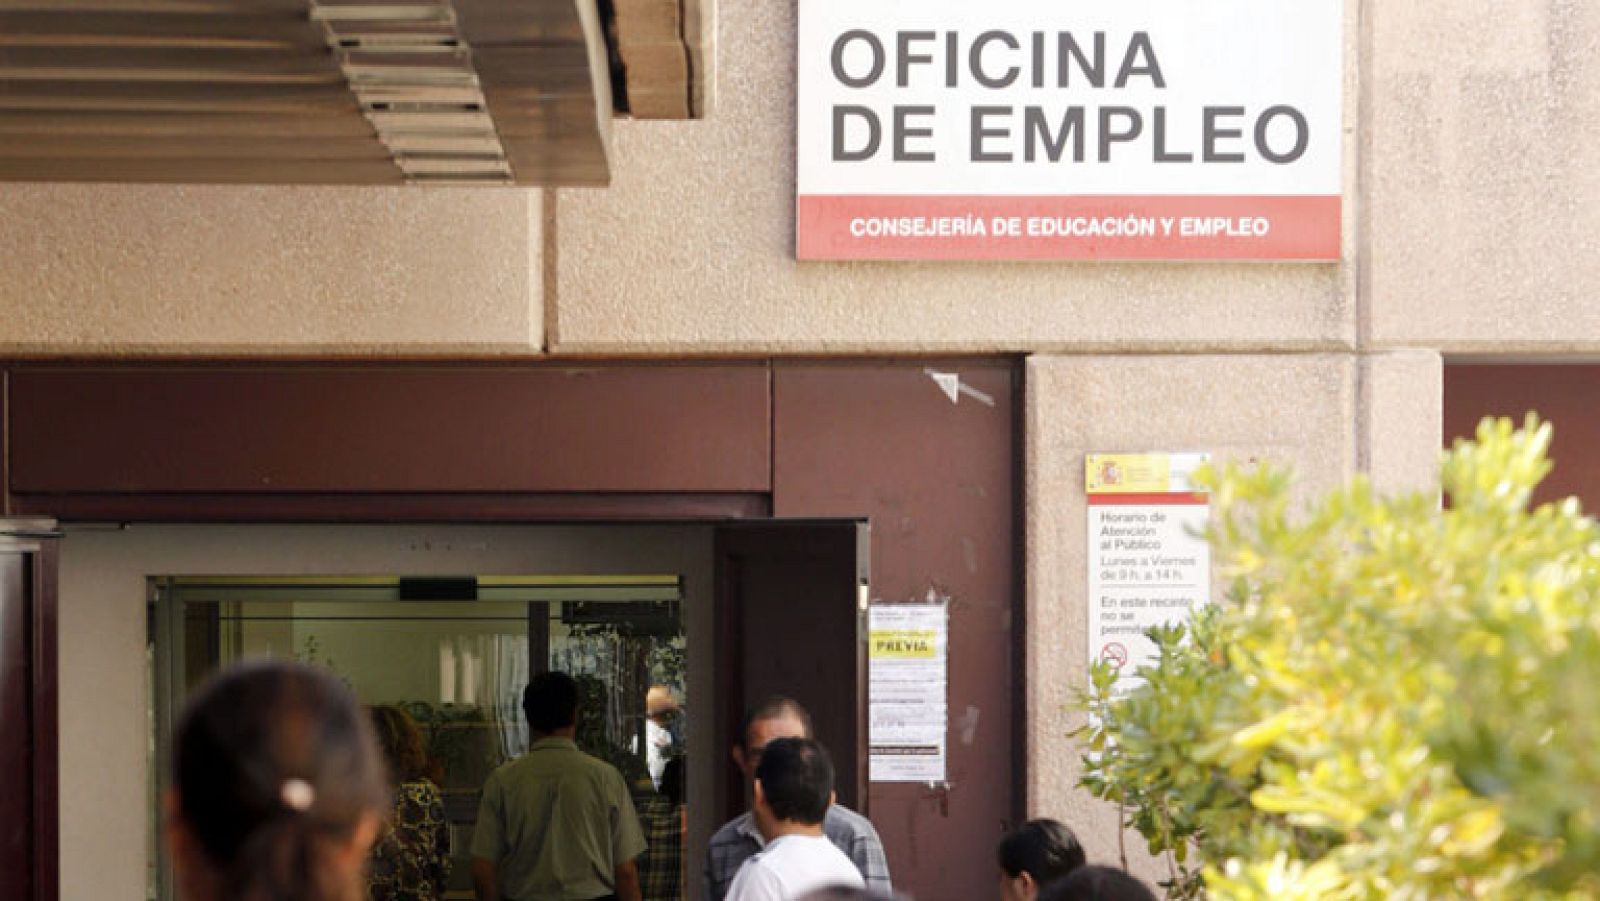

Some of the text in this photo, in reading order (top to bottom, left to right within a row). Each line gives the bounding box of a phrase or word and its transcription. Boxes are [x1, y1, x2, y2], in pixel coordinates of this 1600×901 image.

[831, 30, 1166, 88] OFICINA
[832, 104, 1309, 164] DE EMPLEO
[850, 213, 1270, 237] CONSEJERÍA DE EDUCACIÓN Y EMPLEO
[1101, 511, 1166, 521] Horario de
[1101, 525, 1157, 536] Atención
[1101, 539, 1111, 549] al
[1101, 554, 1196, 566] Lunes a Viernes
[1101, 568, 1116, 580] de
[1101, 596, 1117, 608] En
[1120, 597, 1147, 608] este
[1101, 612, 1135, 621] no se
